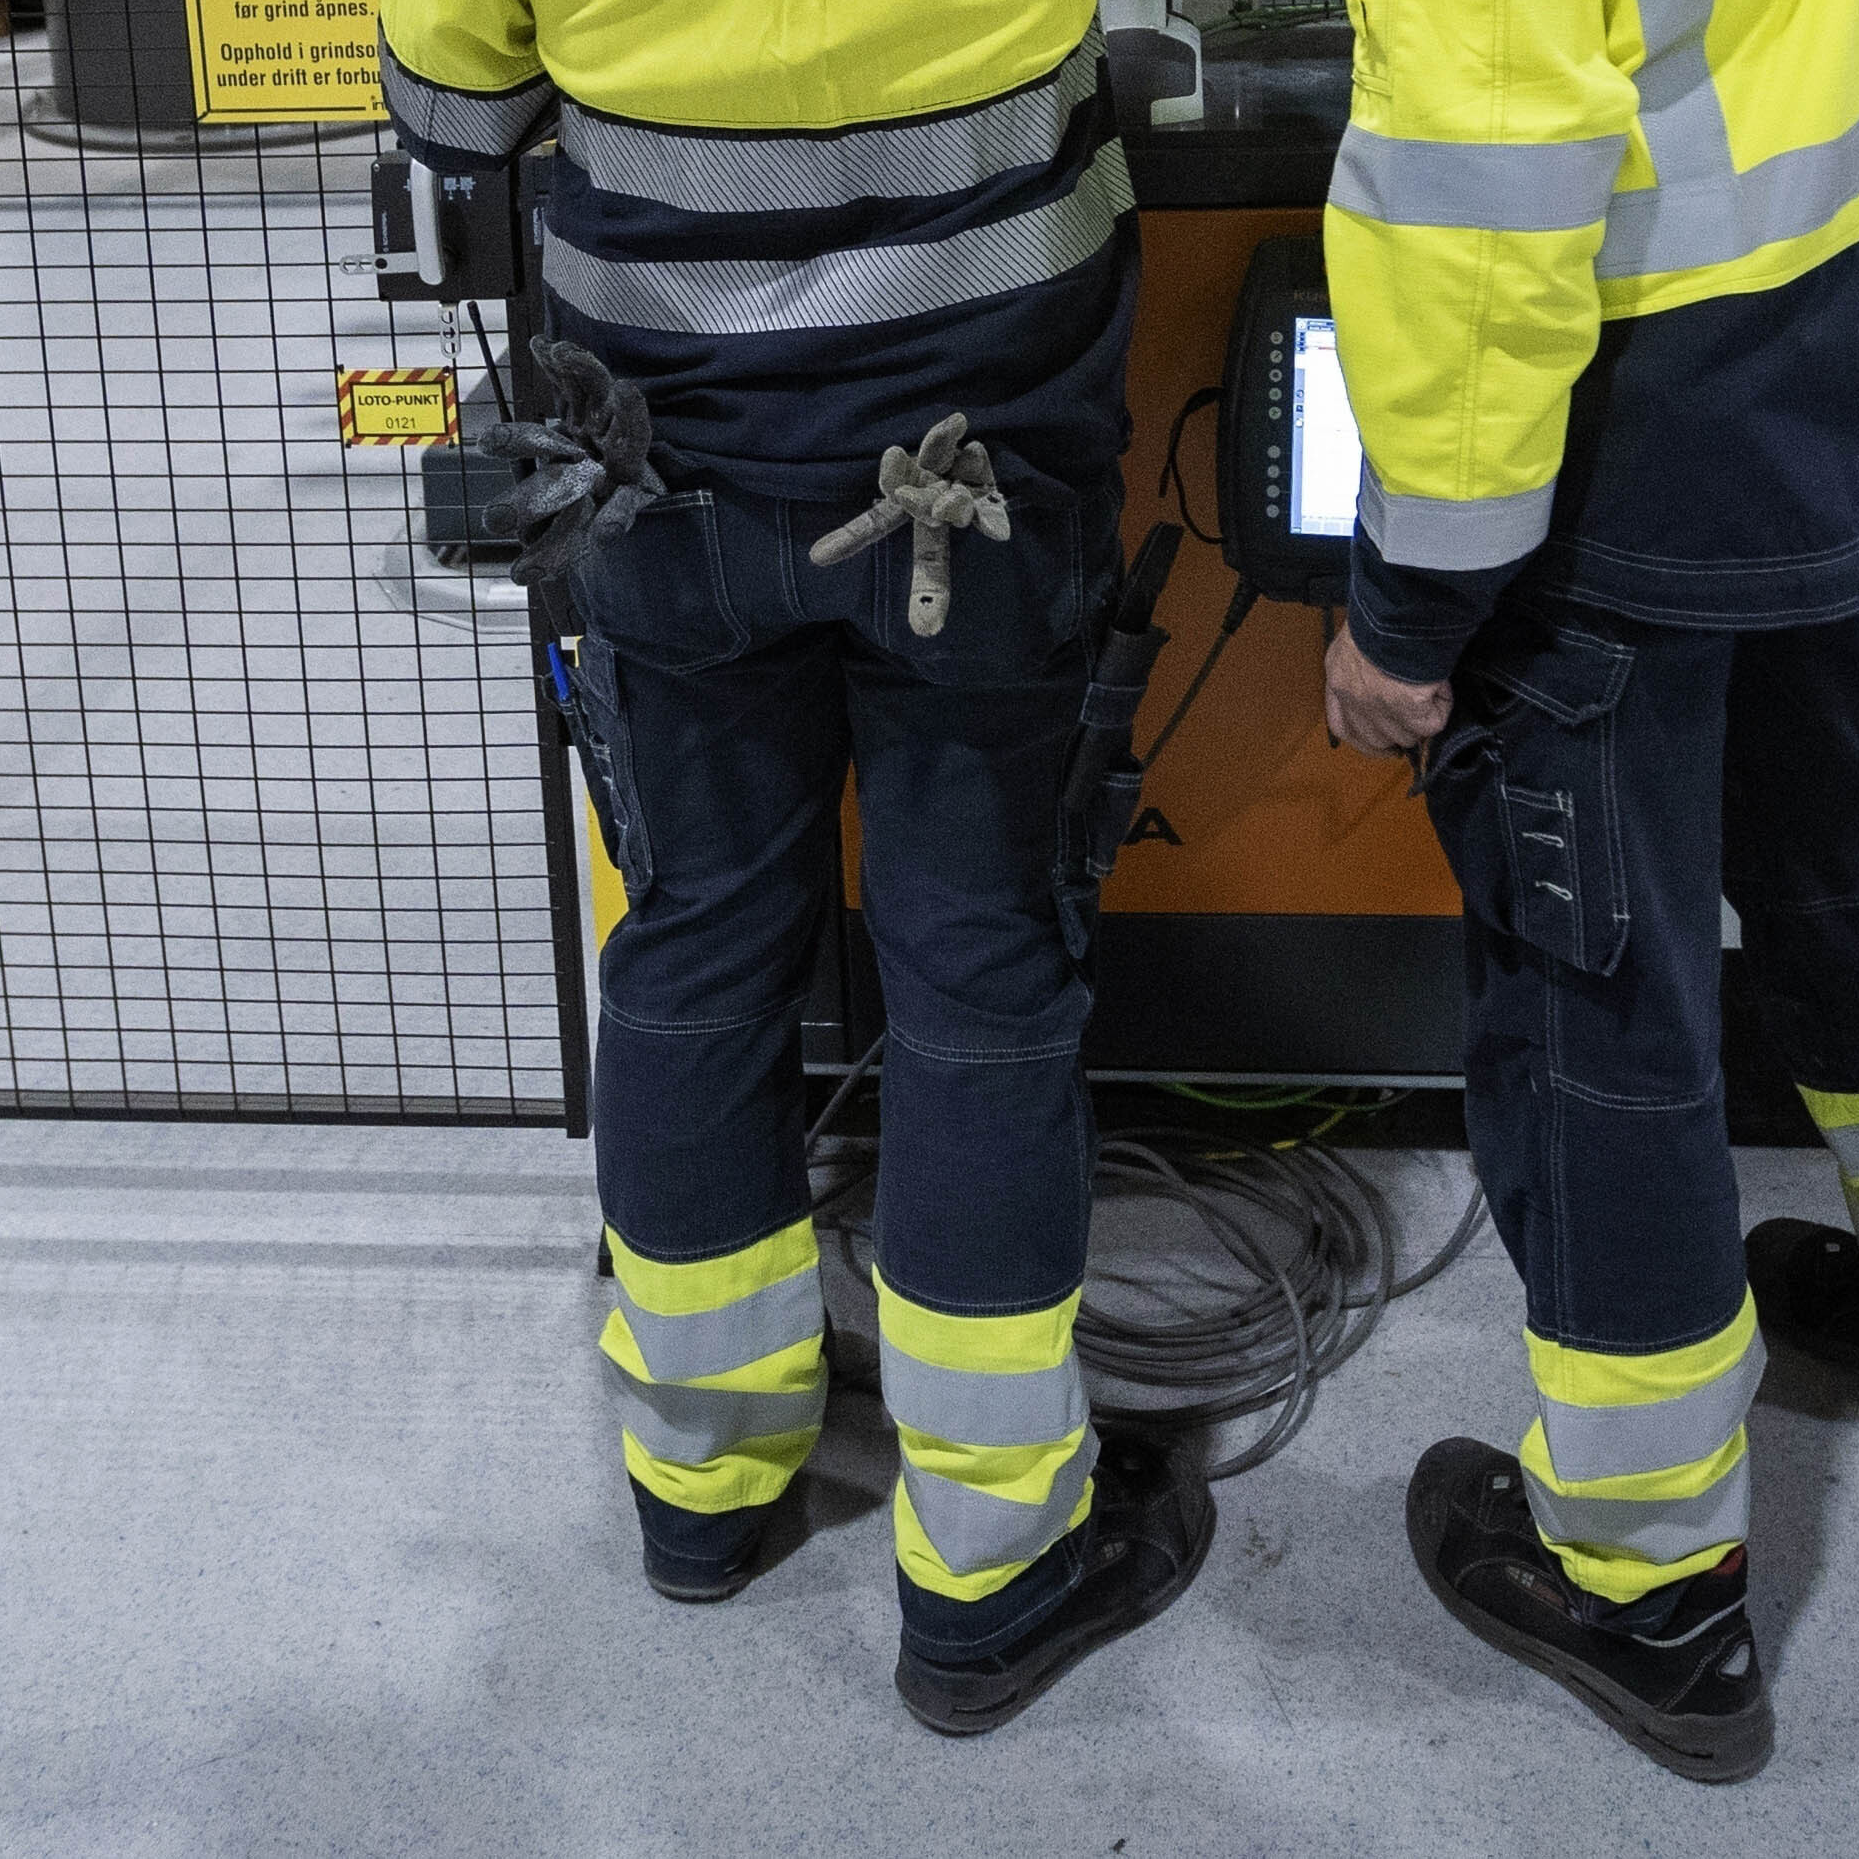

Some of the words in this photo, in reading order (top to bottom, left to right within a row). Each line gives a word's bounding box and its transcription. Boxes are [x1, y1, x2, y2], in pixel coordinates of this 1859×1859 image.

[235, 1, 259, 19] før
[264, 0, 309, 22] grind
[220, 42, 292, 65] Opphold
[298, 42, 304, 60] i
[310, 41, 380, 63] grindso
[216, 70, 267, 87] under
[272, 68, 308, 86] drift
[313, 71, 331, 86] er
[336, 67, 381, 86] forbu
[357, 394, 439, 406] LOTO-PUNKT
[385, 416, 417, 430] 0121
